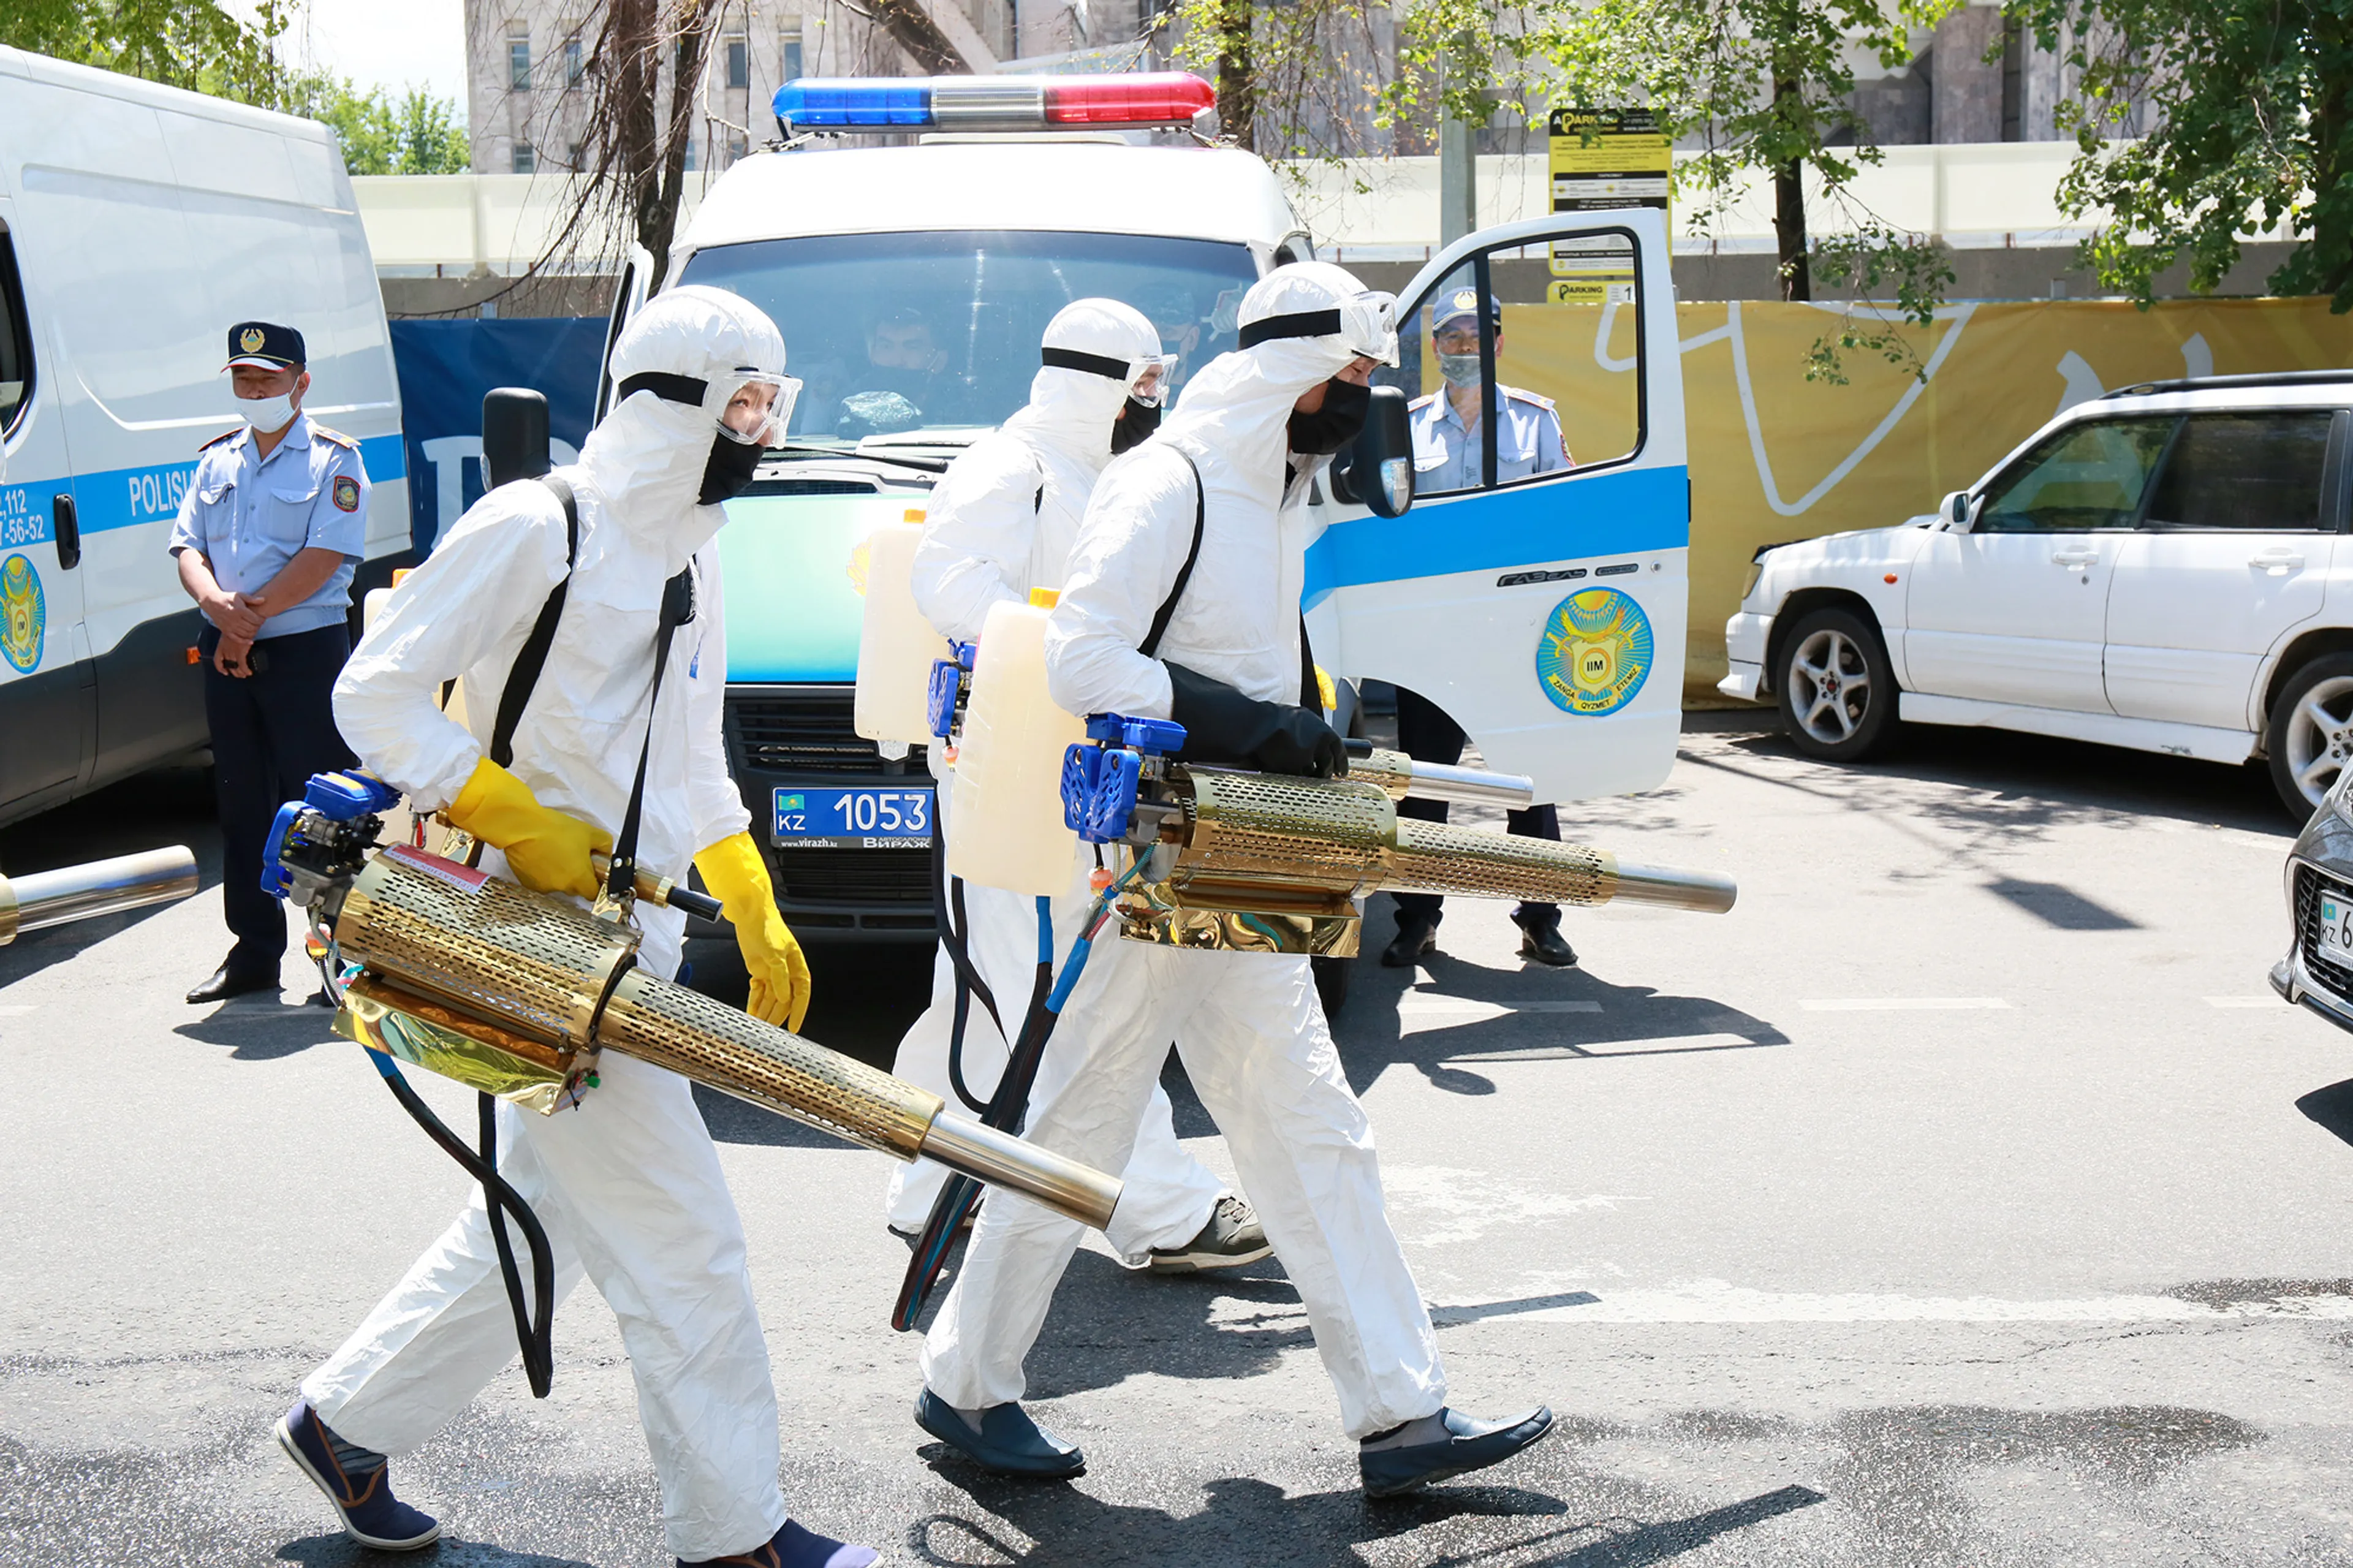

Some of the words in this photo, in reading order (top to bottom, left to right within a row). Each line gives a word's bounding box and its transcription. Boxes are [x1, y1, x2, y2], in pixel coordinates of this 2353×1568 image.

[129, 469, 195, 516] POLISI
[1586, 661, 1604, 671] IIM
[1581, 699, 1610, 710] QYZMET
[1616, 668, 1638, 691] ETEMIZ
[778, 815, 806, 830] KZ
[833, 793, 926, 831] 1053
[781, 838, 838, 848] www.virazh.kz
[420, 864, 474, 891] OPERATION
[2321, 923, 2335, 944] KZ
